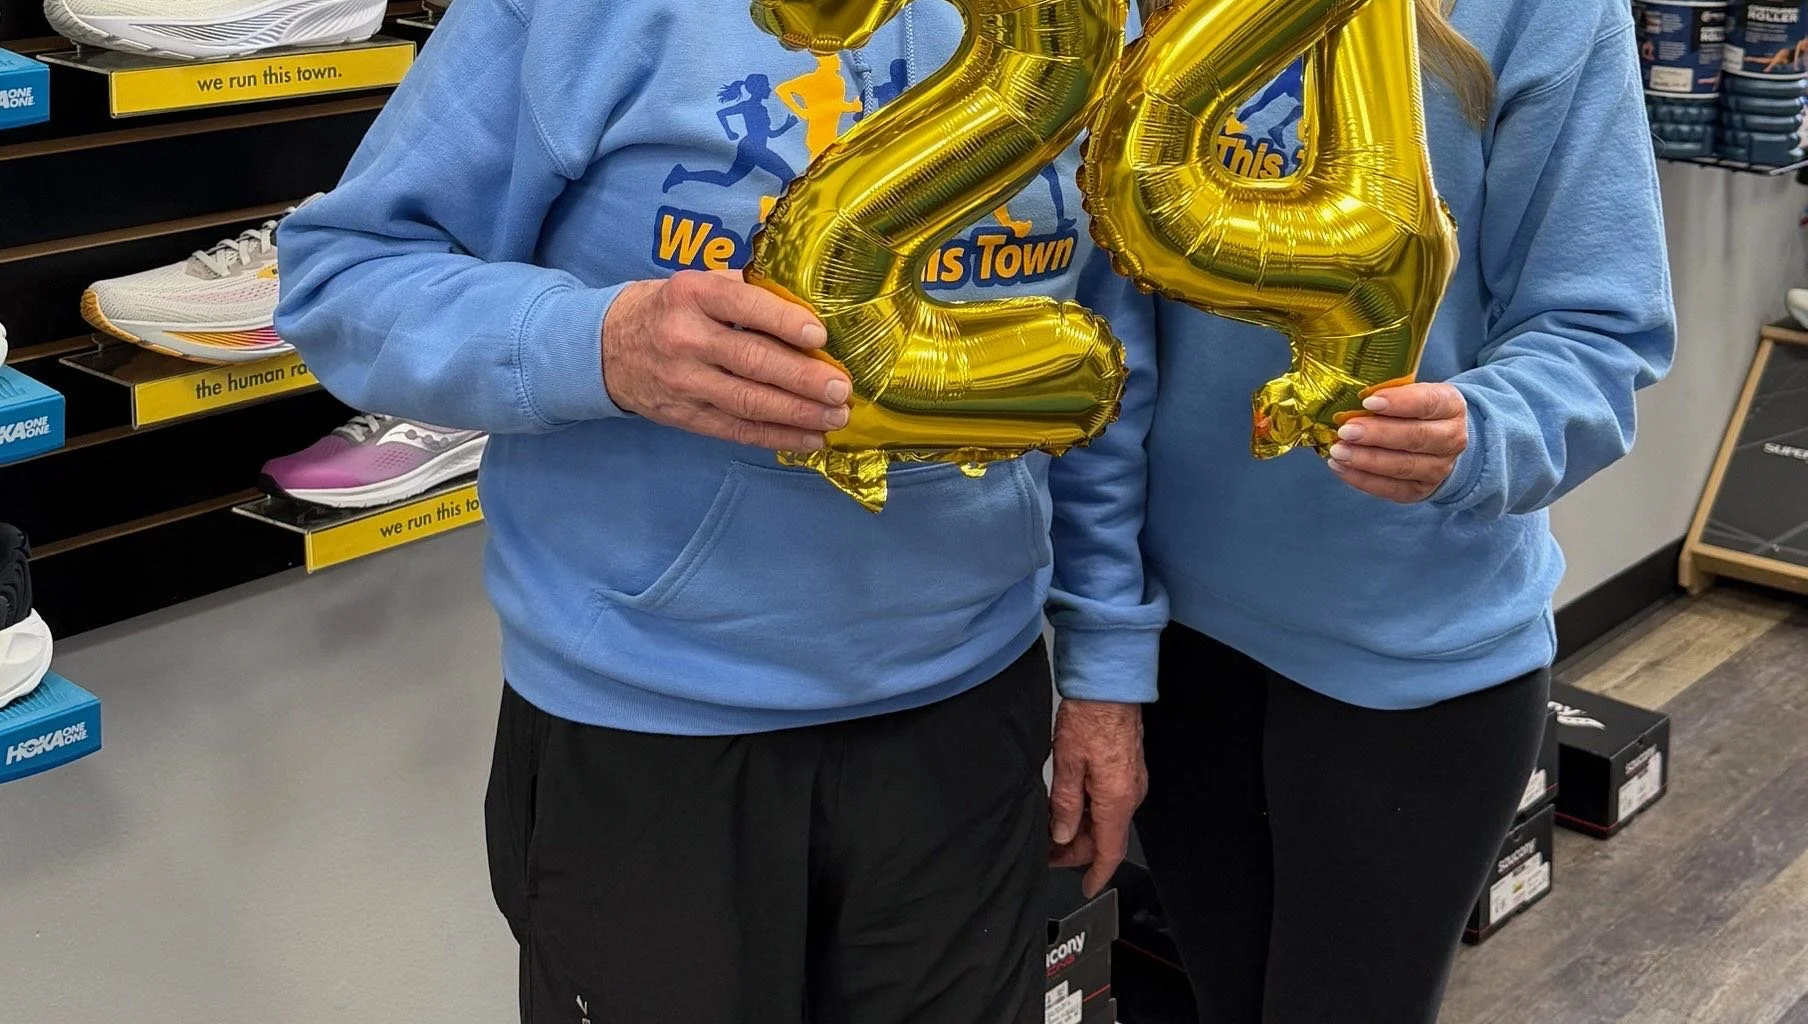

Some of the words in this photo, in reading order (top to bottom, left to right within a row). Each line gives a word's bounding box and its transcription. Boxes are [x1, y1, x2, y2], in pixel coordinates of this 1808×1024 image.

[8, 87, 33, 98] ONE
[197, 77, 223, 92] we
[229, 72, 257, 89] run
[263, 65, 291, 86] this
[297, 63, 343, 82] town.
[1217, 136, 1284, 179] This
[659, 214, 736, 270] We
[920, 247, 965, 283] is
[977, 234, 1074, 280] Town
[195, 379, 223, 400] the
[228, 362, 285, 394] human
[290, 363, 308, 378] ra
[0, 421, 26, 445] KA
[25, 416, 49, 429] ONE
[379, 522, 403, 538] we
[407, 511, 432, 530] run
[436, 501, 461, 522] this
[465, 494, 480, 511] to
[5, 729, 65, 766] HOKA
[63, 721, 86, 737] ONE
[64, 730, 89, 745] ONE
[1046, 931, 1086, 967] cony
